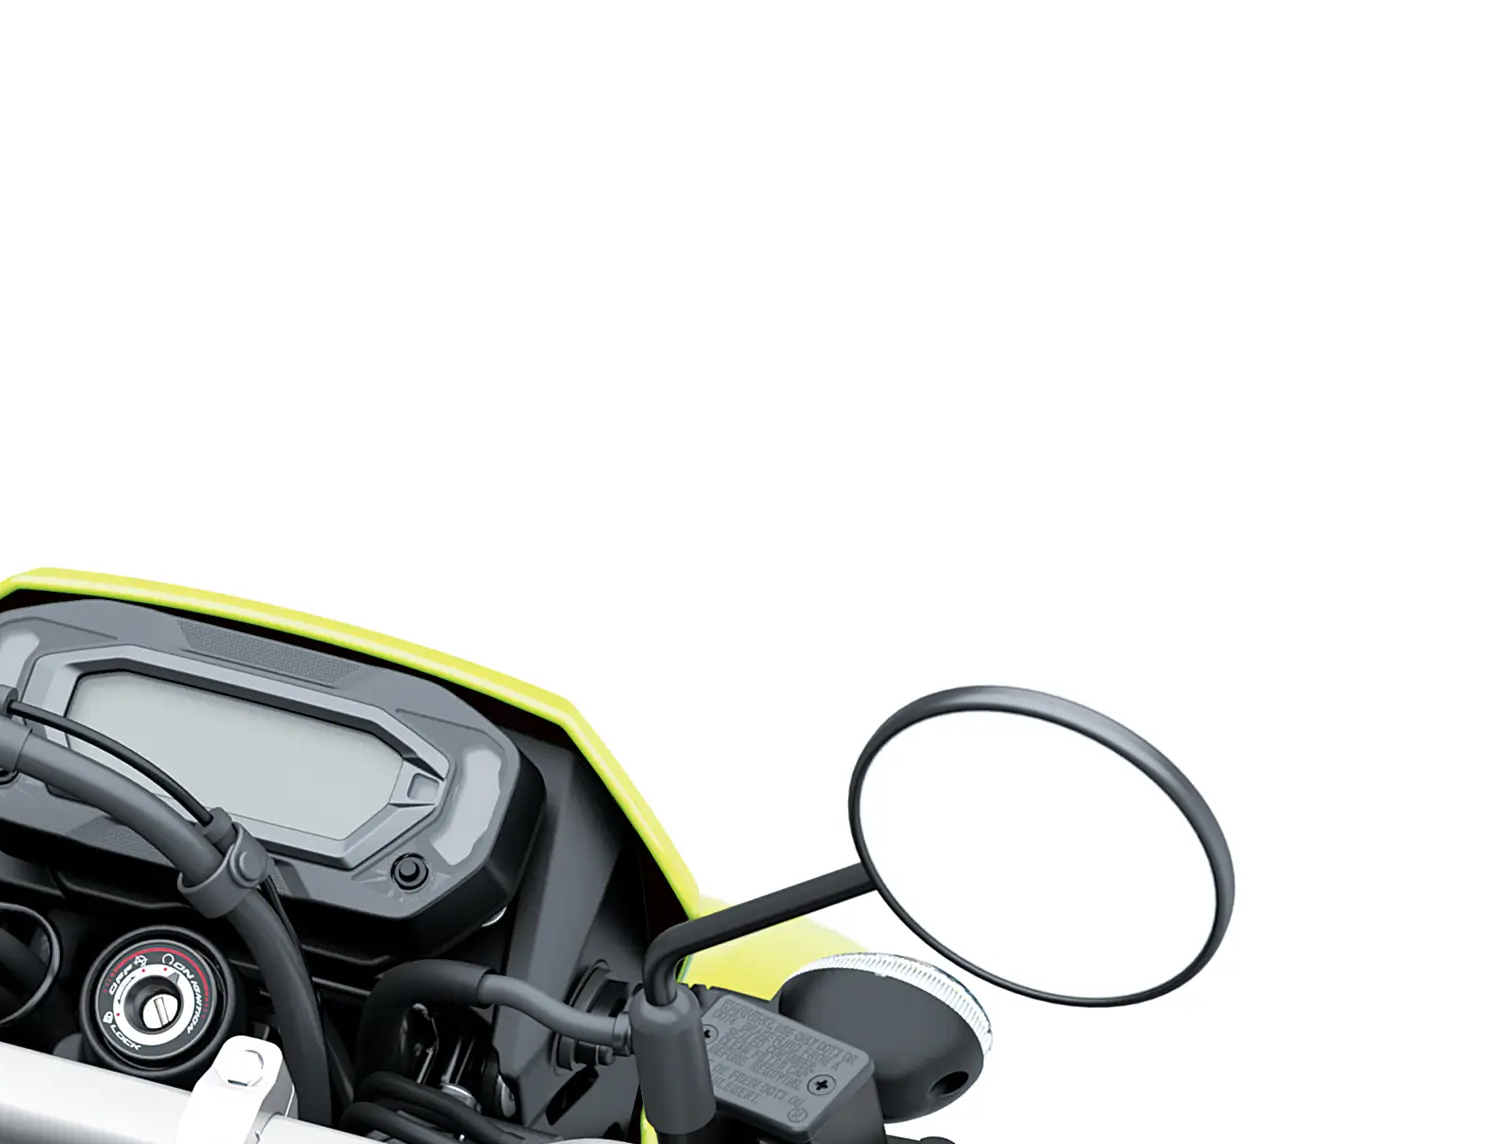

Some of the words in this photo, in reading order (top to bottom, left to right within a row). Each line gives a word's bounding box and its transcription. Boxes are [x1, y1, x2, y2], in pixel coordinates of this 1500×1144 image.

[108, 964, 133, 995] OFF
[173, 962, 194, 980] ON
[187, 980, 203, 1034] IGNITION
[110, 1024, 141, 1051] LOCK
